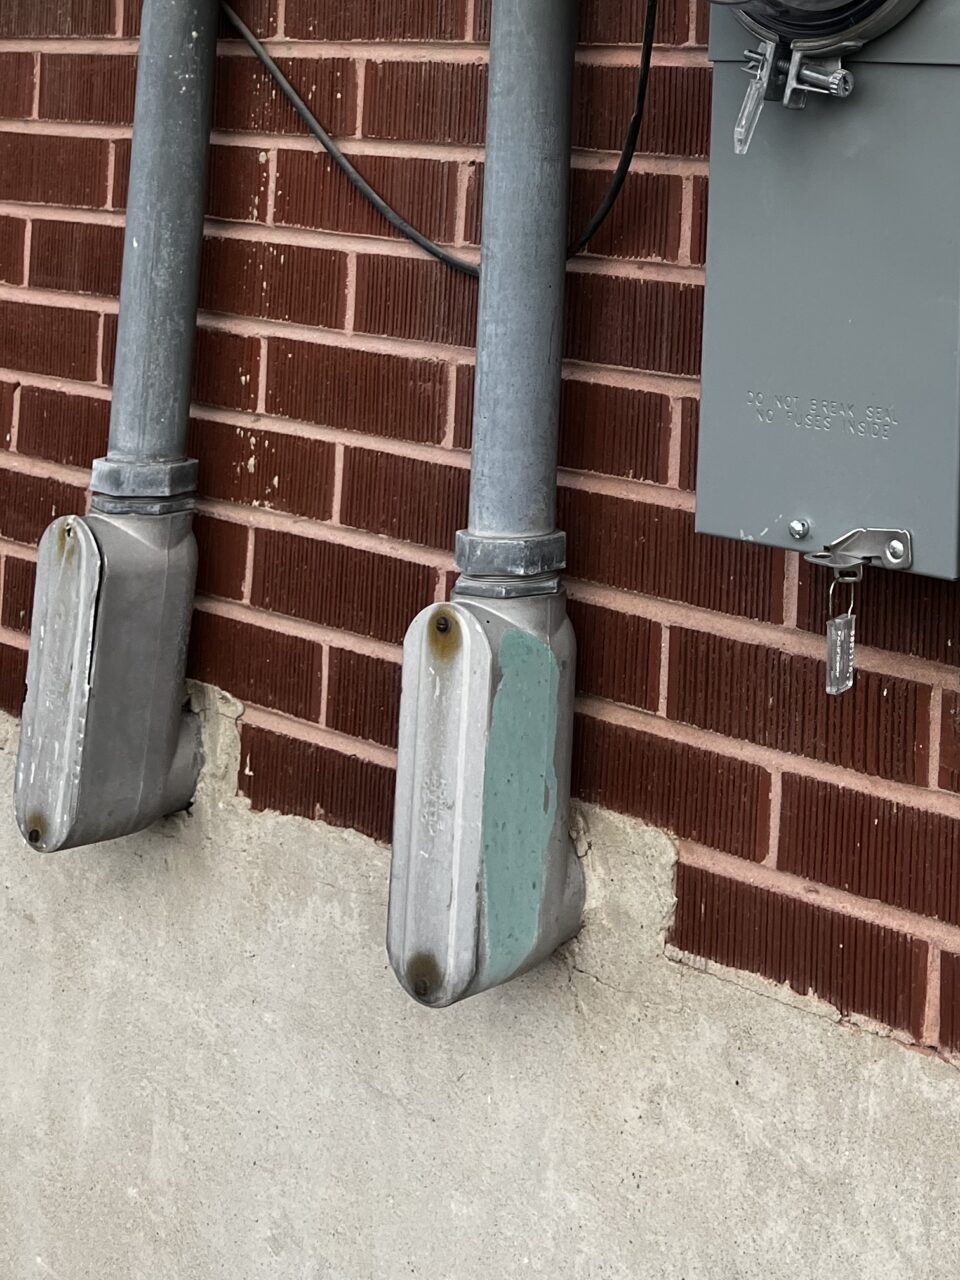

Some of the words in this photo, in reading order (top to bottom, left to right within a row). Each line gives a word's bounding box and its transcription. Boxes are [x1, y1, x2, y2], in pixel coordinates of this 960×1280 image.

[747, 390, 764, 406] DO
[775, 394, 799, 409] NOT
[810, 398, 855, 418] BREAK
[865, 404, 899, 425] SEAL
[757, 408, 774, 424] NO
[786, 411, 832, 431] FUSES
[842, 419, 890, 440] INSIDE
